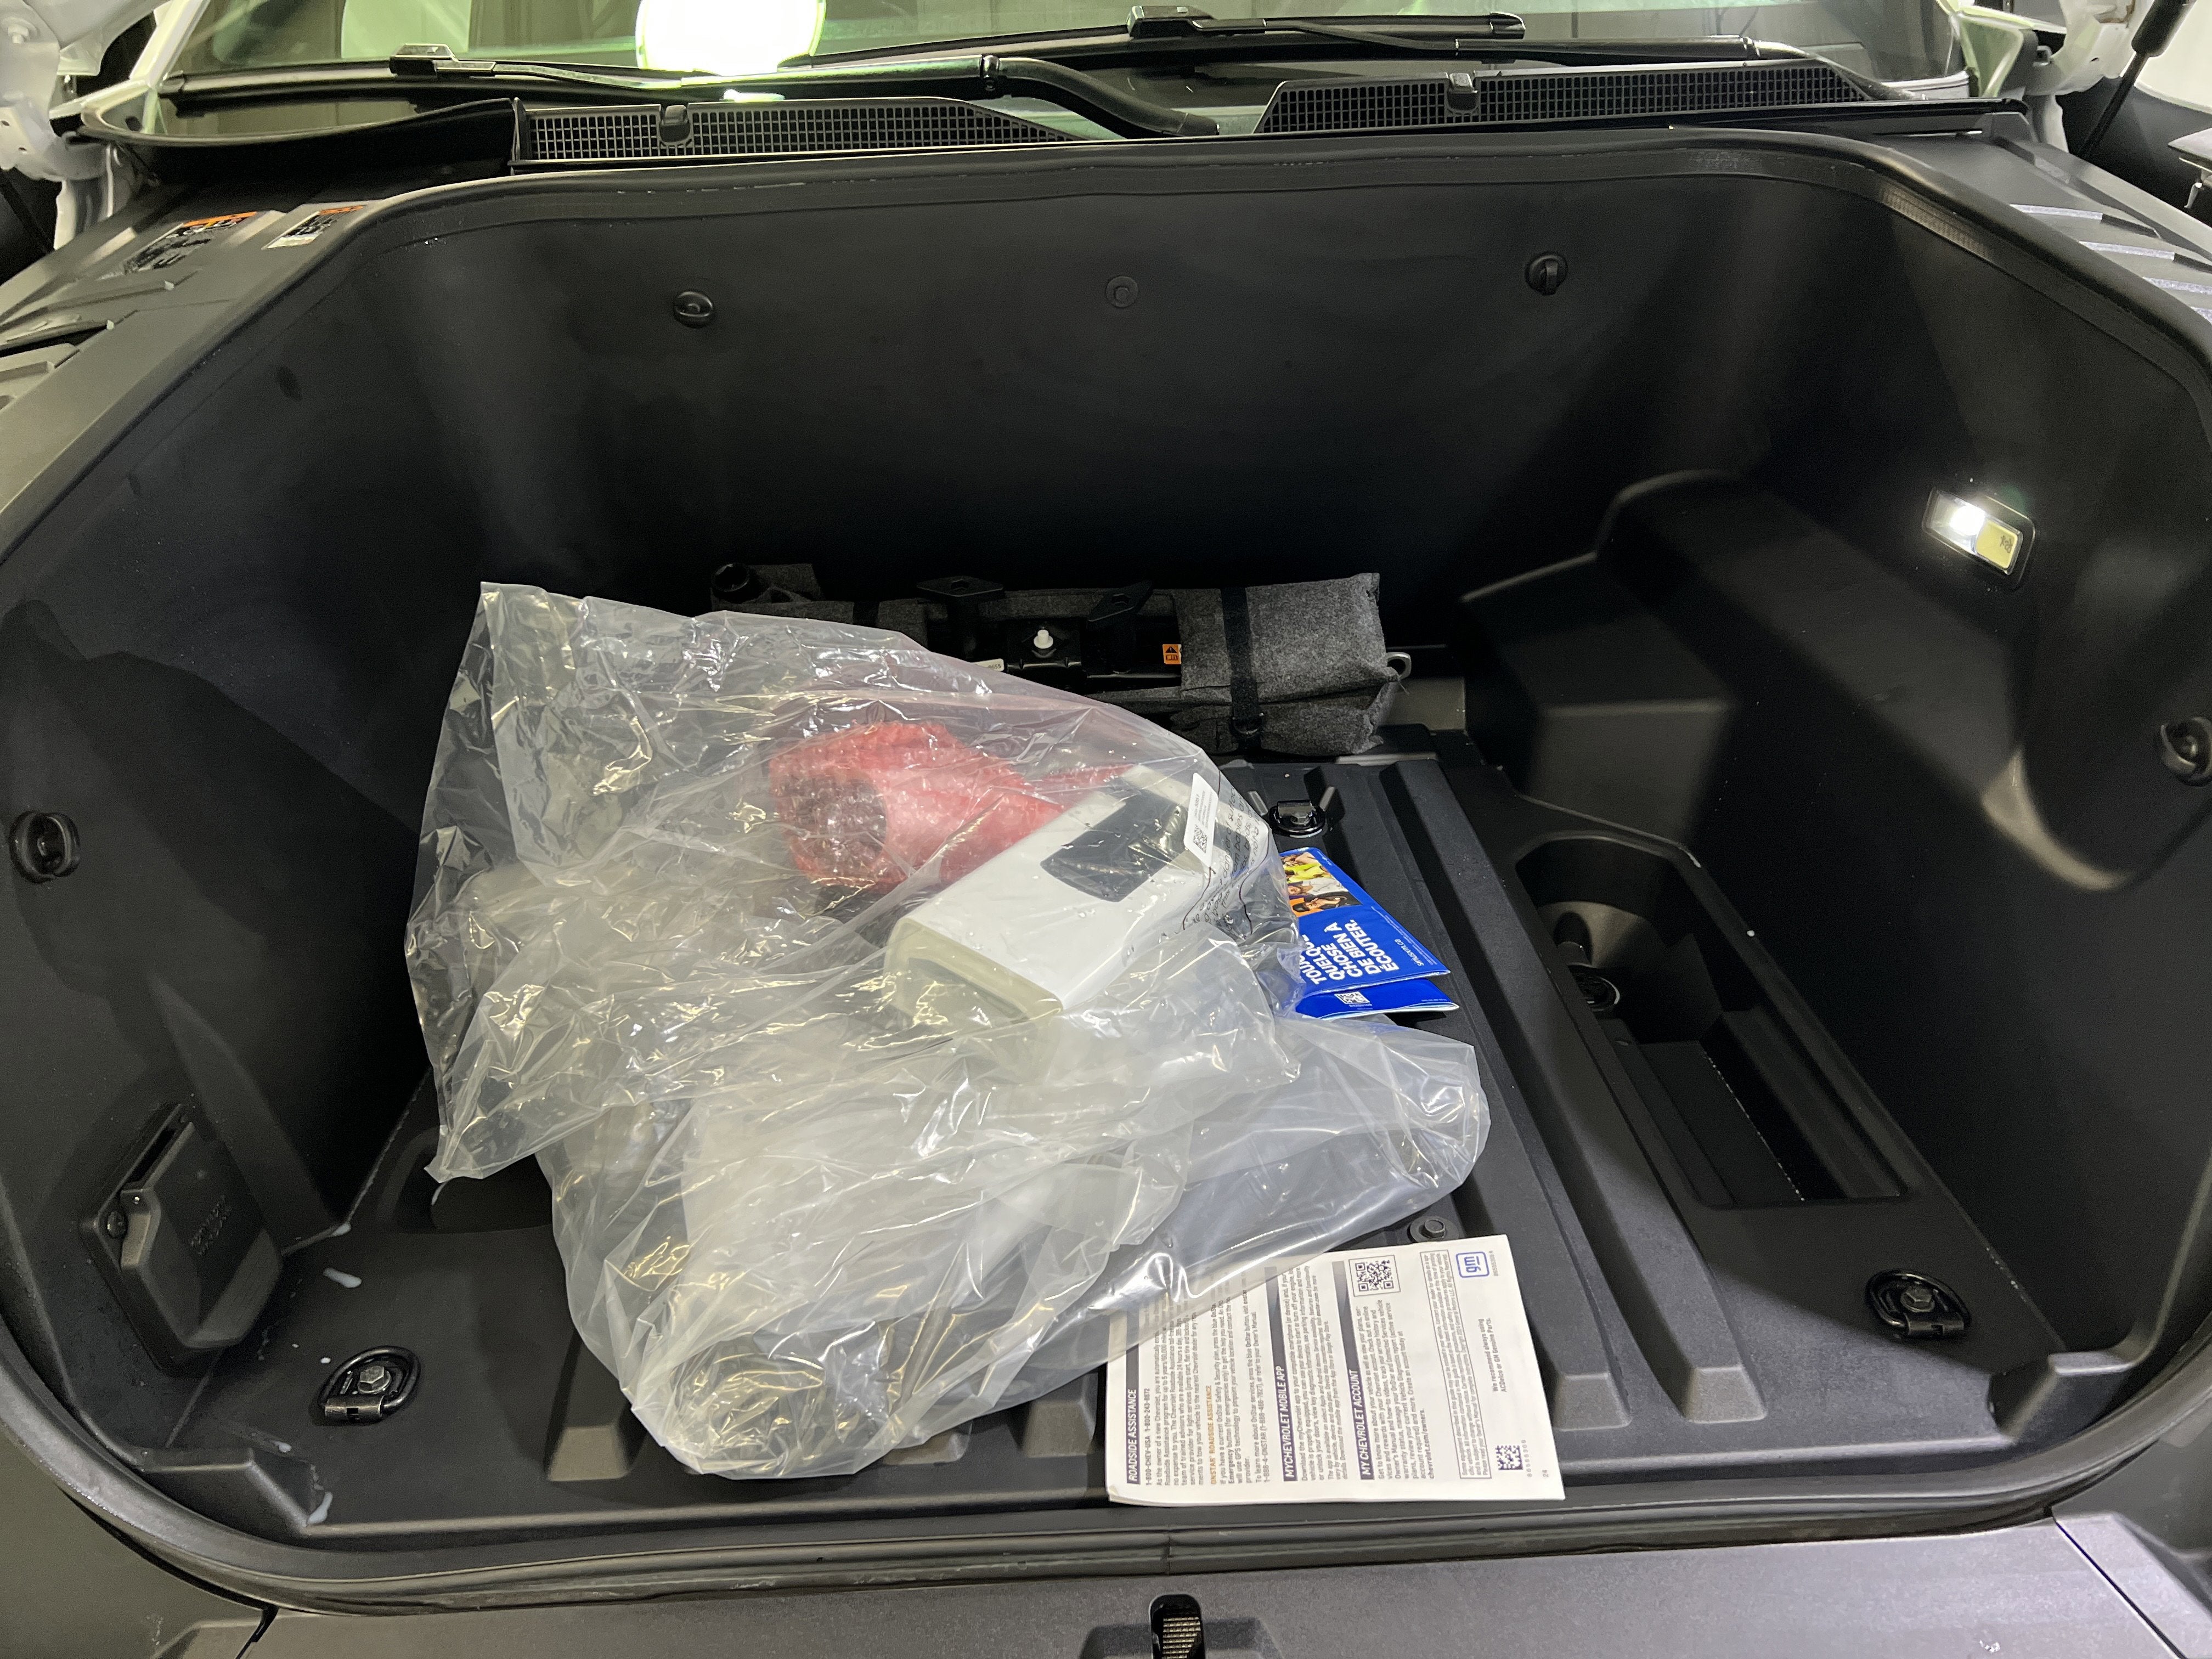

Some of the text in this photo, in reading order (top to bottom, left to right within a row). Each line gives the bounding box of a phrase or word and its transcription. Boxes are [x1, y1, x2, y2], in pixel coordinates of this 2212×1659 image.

[1226, 820, 1232, 834] of
[1234, 812, 1243, 851] babies
[1223, 835, 1232, 878] danger
[1324, 922, 1342, 933] À
[1333, 933, 1366, 958] BIEN
[1344, 919, 1400, 972] ÉCOUTER.
[1394, 939, 1424, 966] siriusxm.ca
[1321, 943, 1363, 977] CHOSE
[1357, 958, 1382, 974] DE
[1463, 1255, 1482, 1273] gm
[1484, 1317, 1493, 1333] Parts.
[1477, 1318, 1499, 1392] We recommend always using
[1488, 1333, 1498, 1353] Genuine
[1493, 1354, 1500, 1362] GM
[1496, 1369, 1507, 1392] ACDelco
[1275, 1365, 1294, 1477] MYCHEVROLET MOBILE APP
[1348, 1368, 1371, 1475] MY CHEVROLET ACCOUNT
[1127, 1389, 1137, 1482] ROADSIDE ASSISTANCE
[1207, 1422, 1215, 1454] ROADSIDE
[1226, 1448, 1236, 1484] Emergency
[1543, 1469, 1549, 1478] 24
